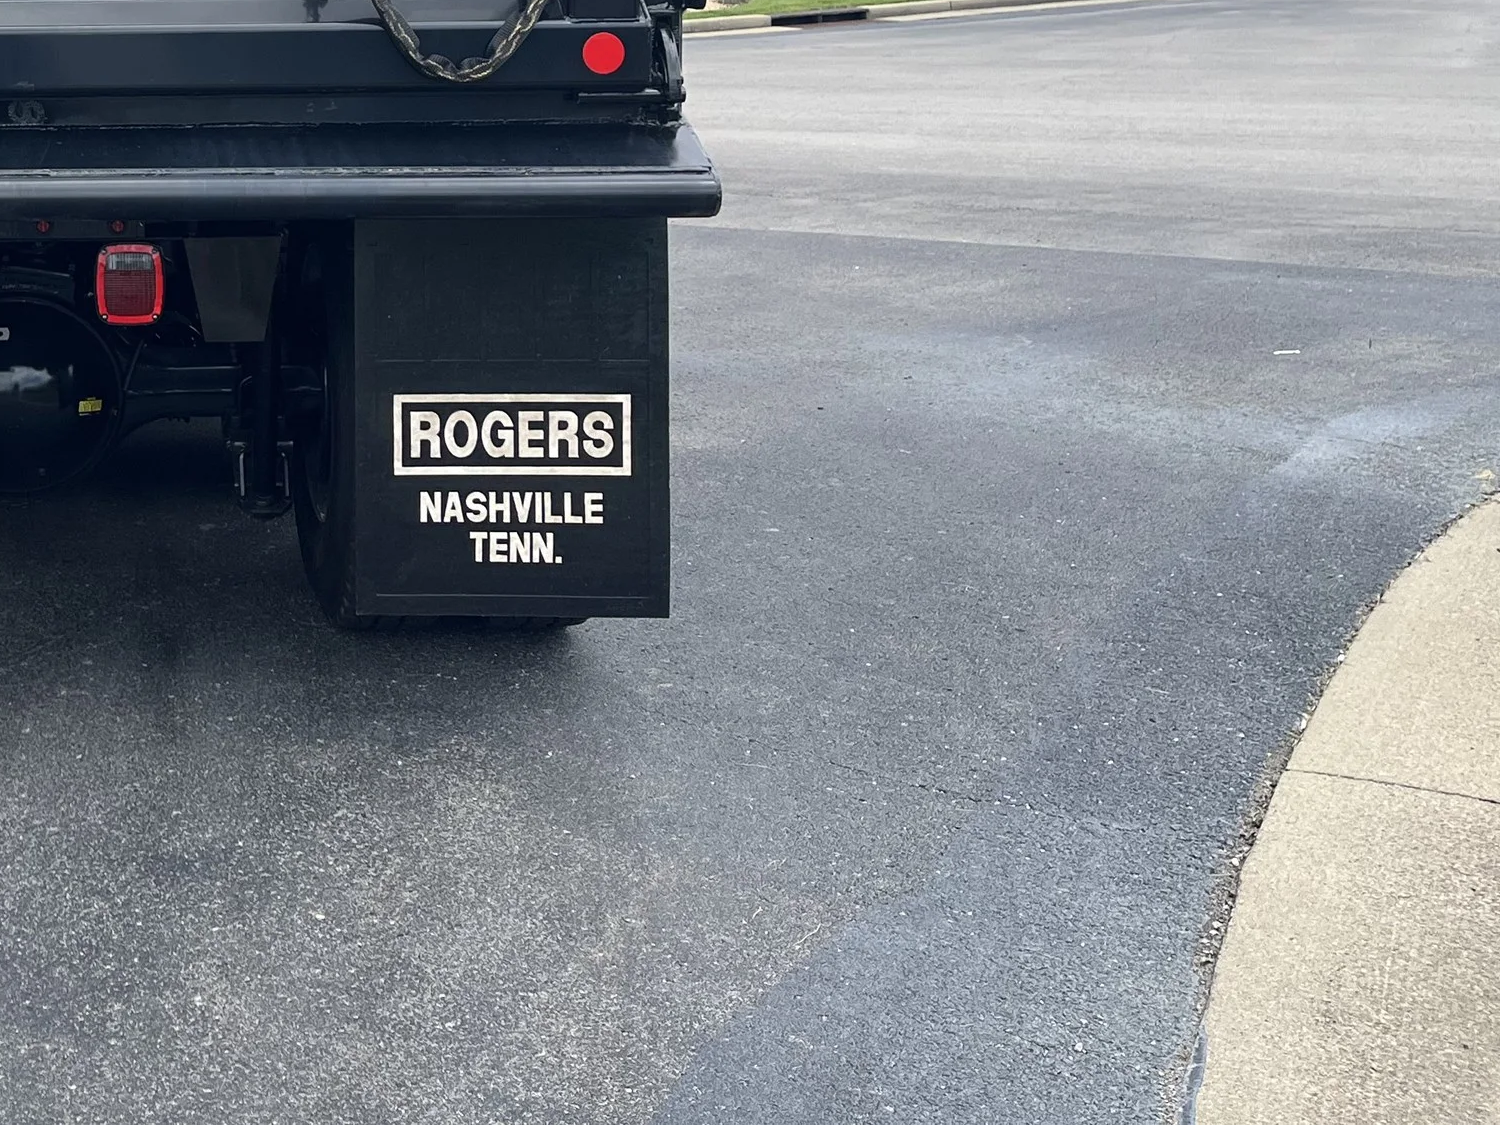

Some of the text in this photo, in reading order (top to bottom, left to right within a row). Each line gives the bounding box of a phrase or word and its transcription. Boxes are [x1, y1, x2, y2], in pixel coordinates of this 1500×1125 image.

[409, 409, 615, 459] ROGERS
[419, 491, 604, 524] NASHVILLE
[469, 531, 563, 564] TENN.
